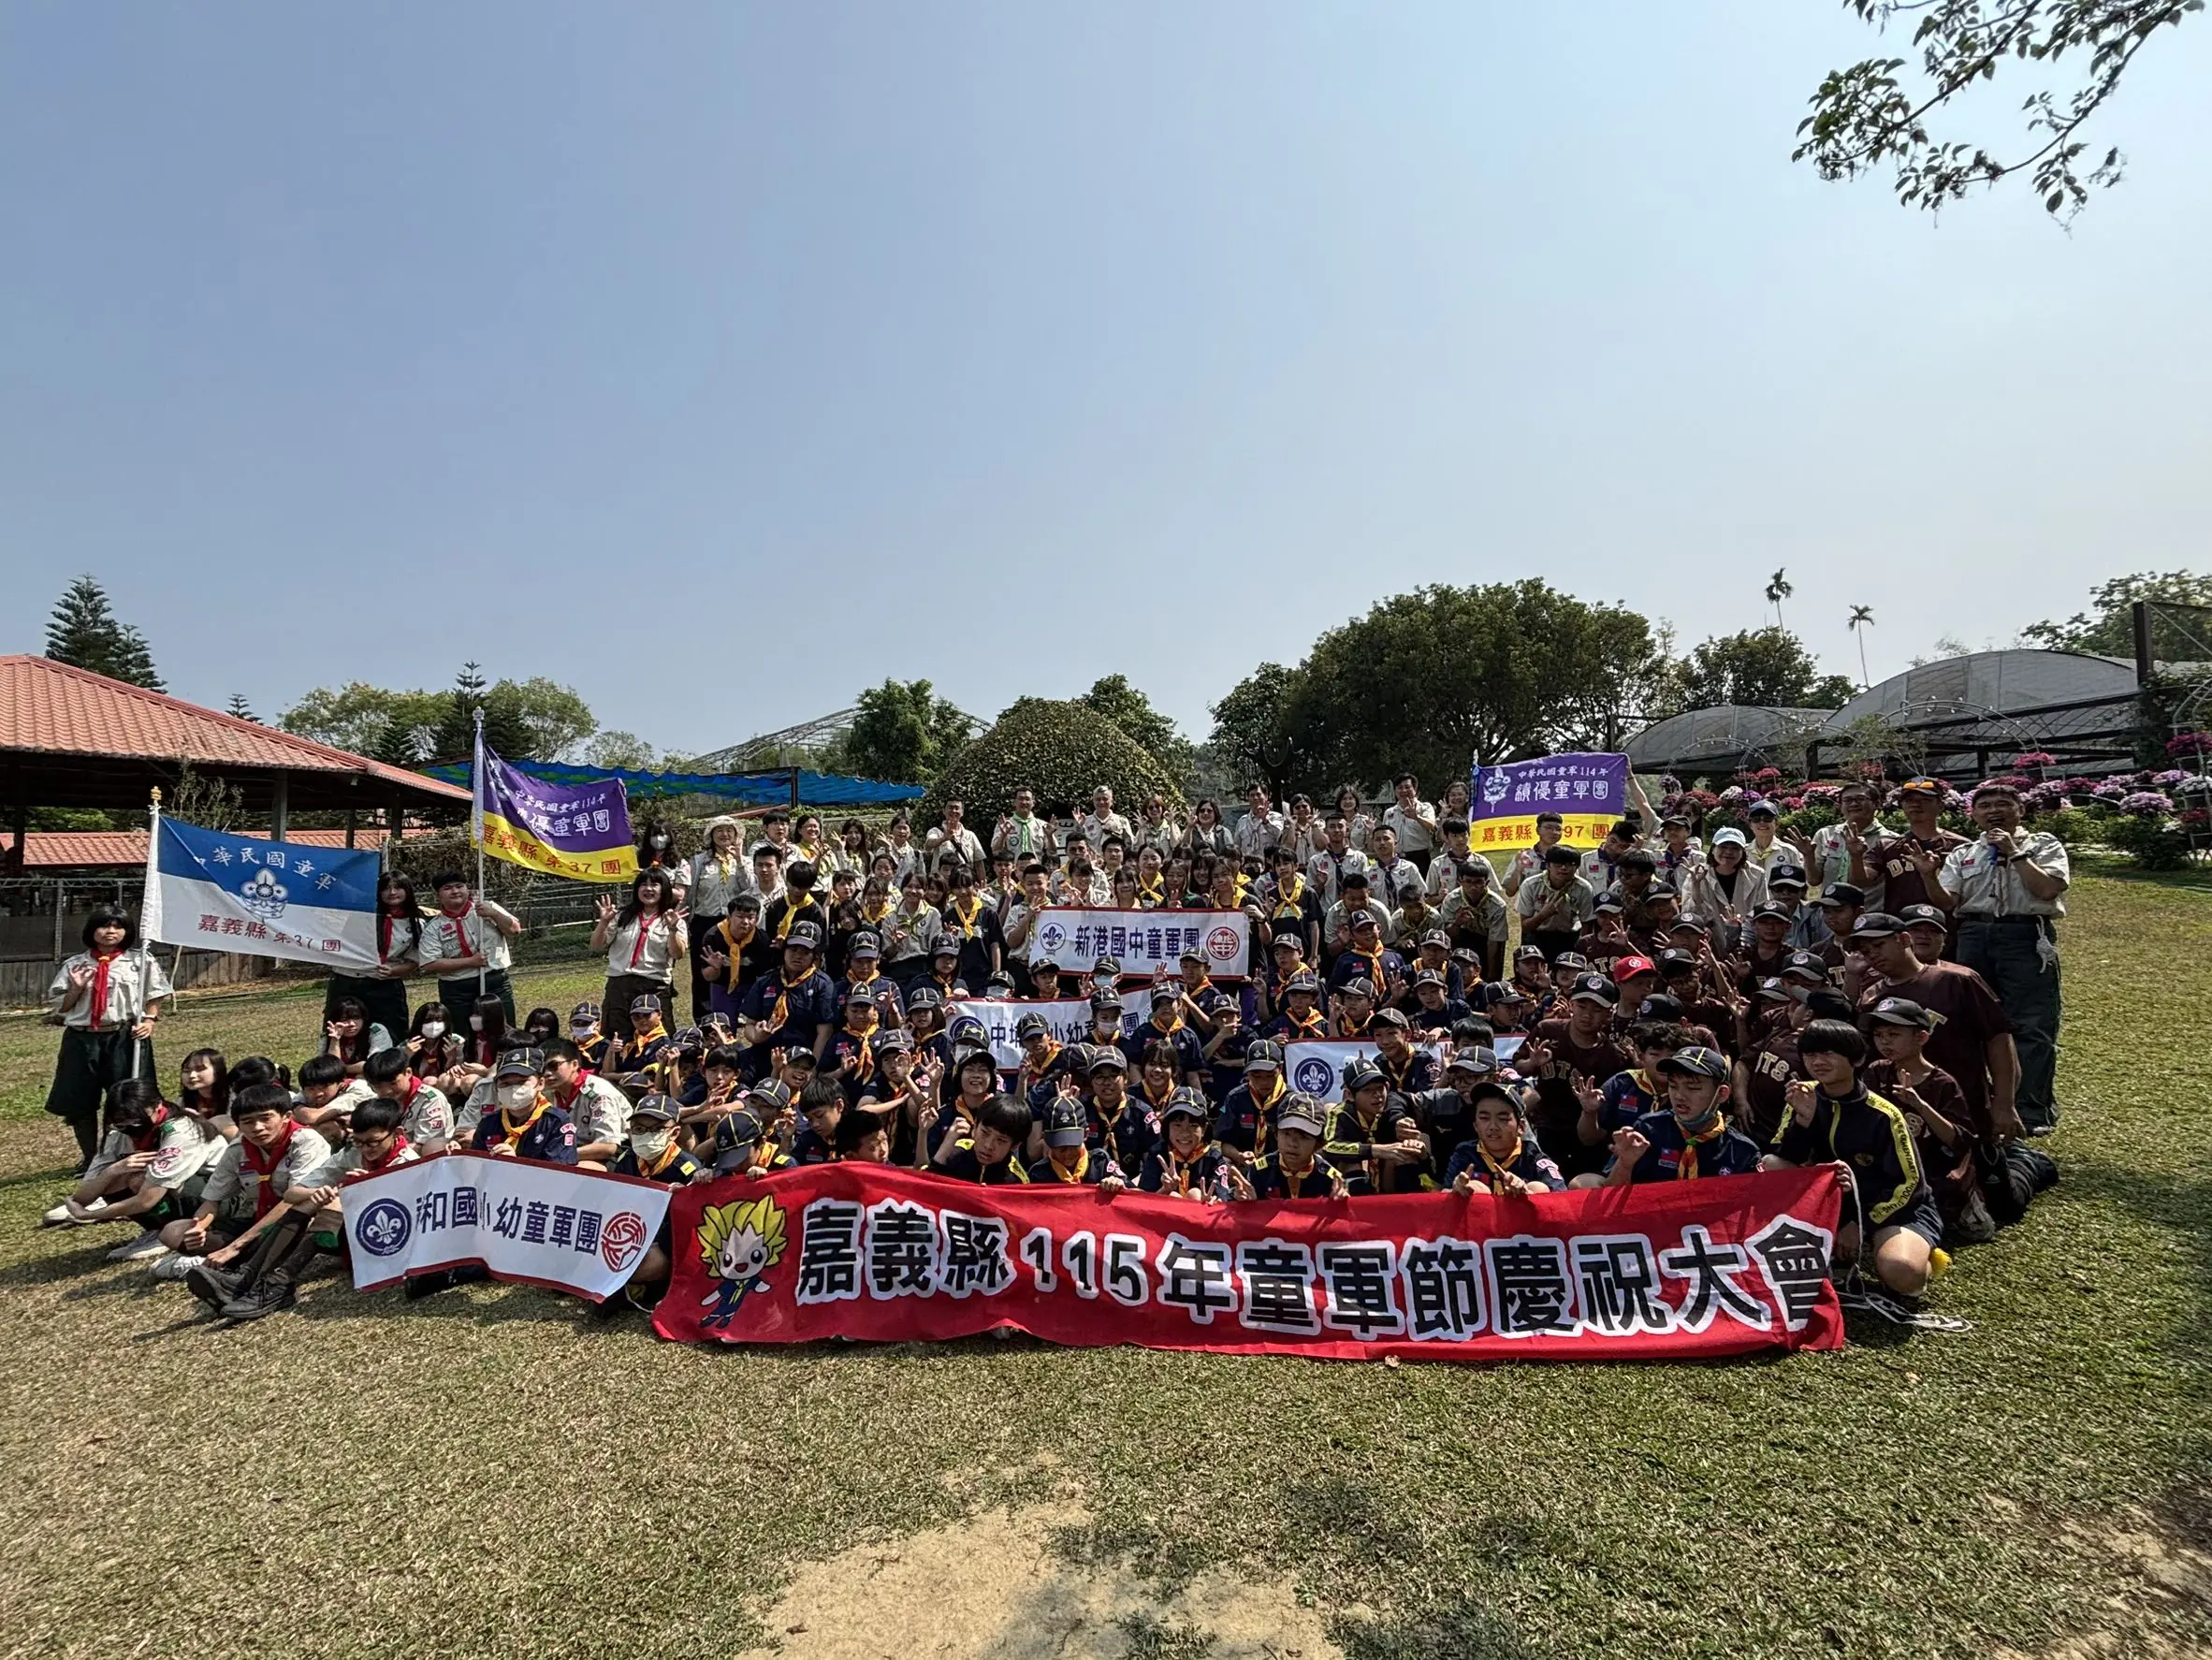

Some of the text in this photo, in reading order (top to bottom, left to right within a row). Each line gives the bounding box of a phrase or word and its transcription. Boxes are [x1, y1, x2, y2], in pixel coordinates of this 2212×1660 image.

[1514, 780, 1608, 802] 績優童軍團
[1481, 823, 1609, 843] 嘉義縣97團
[198, 847, 337, 891] 華民國童軍
[1074, 925, 1200, 960] 新港國中童軍團
[415, 1186, 603, 1256] 和國小幼童軍團
[797, 1199, 1831, 1341] 嘉義縣115年童軍節慶祝大會
